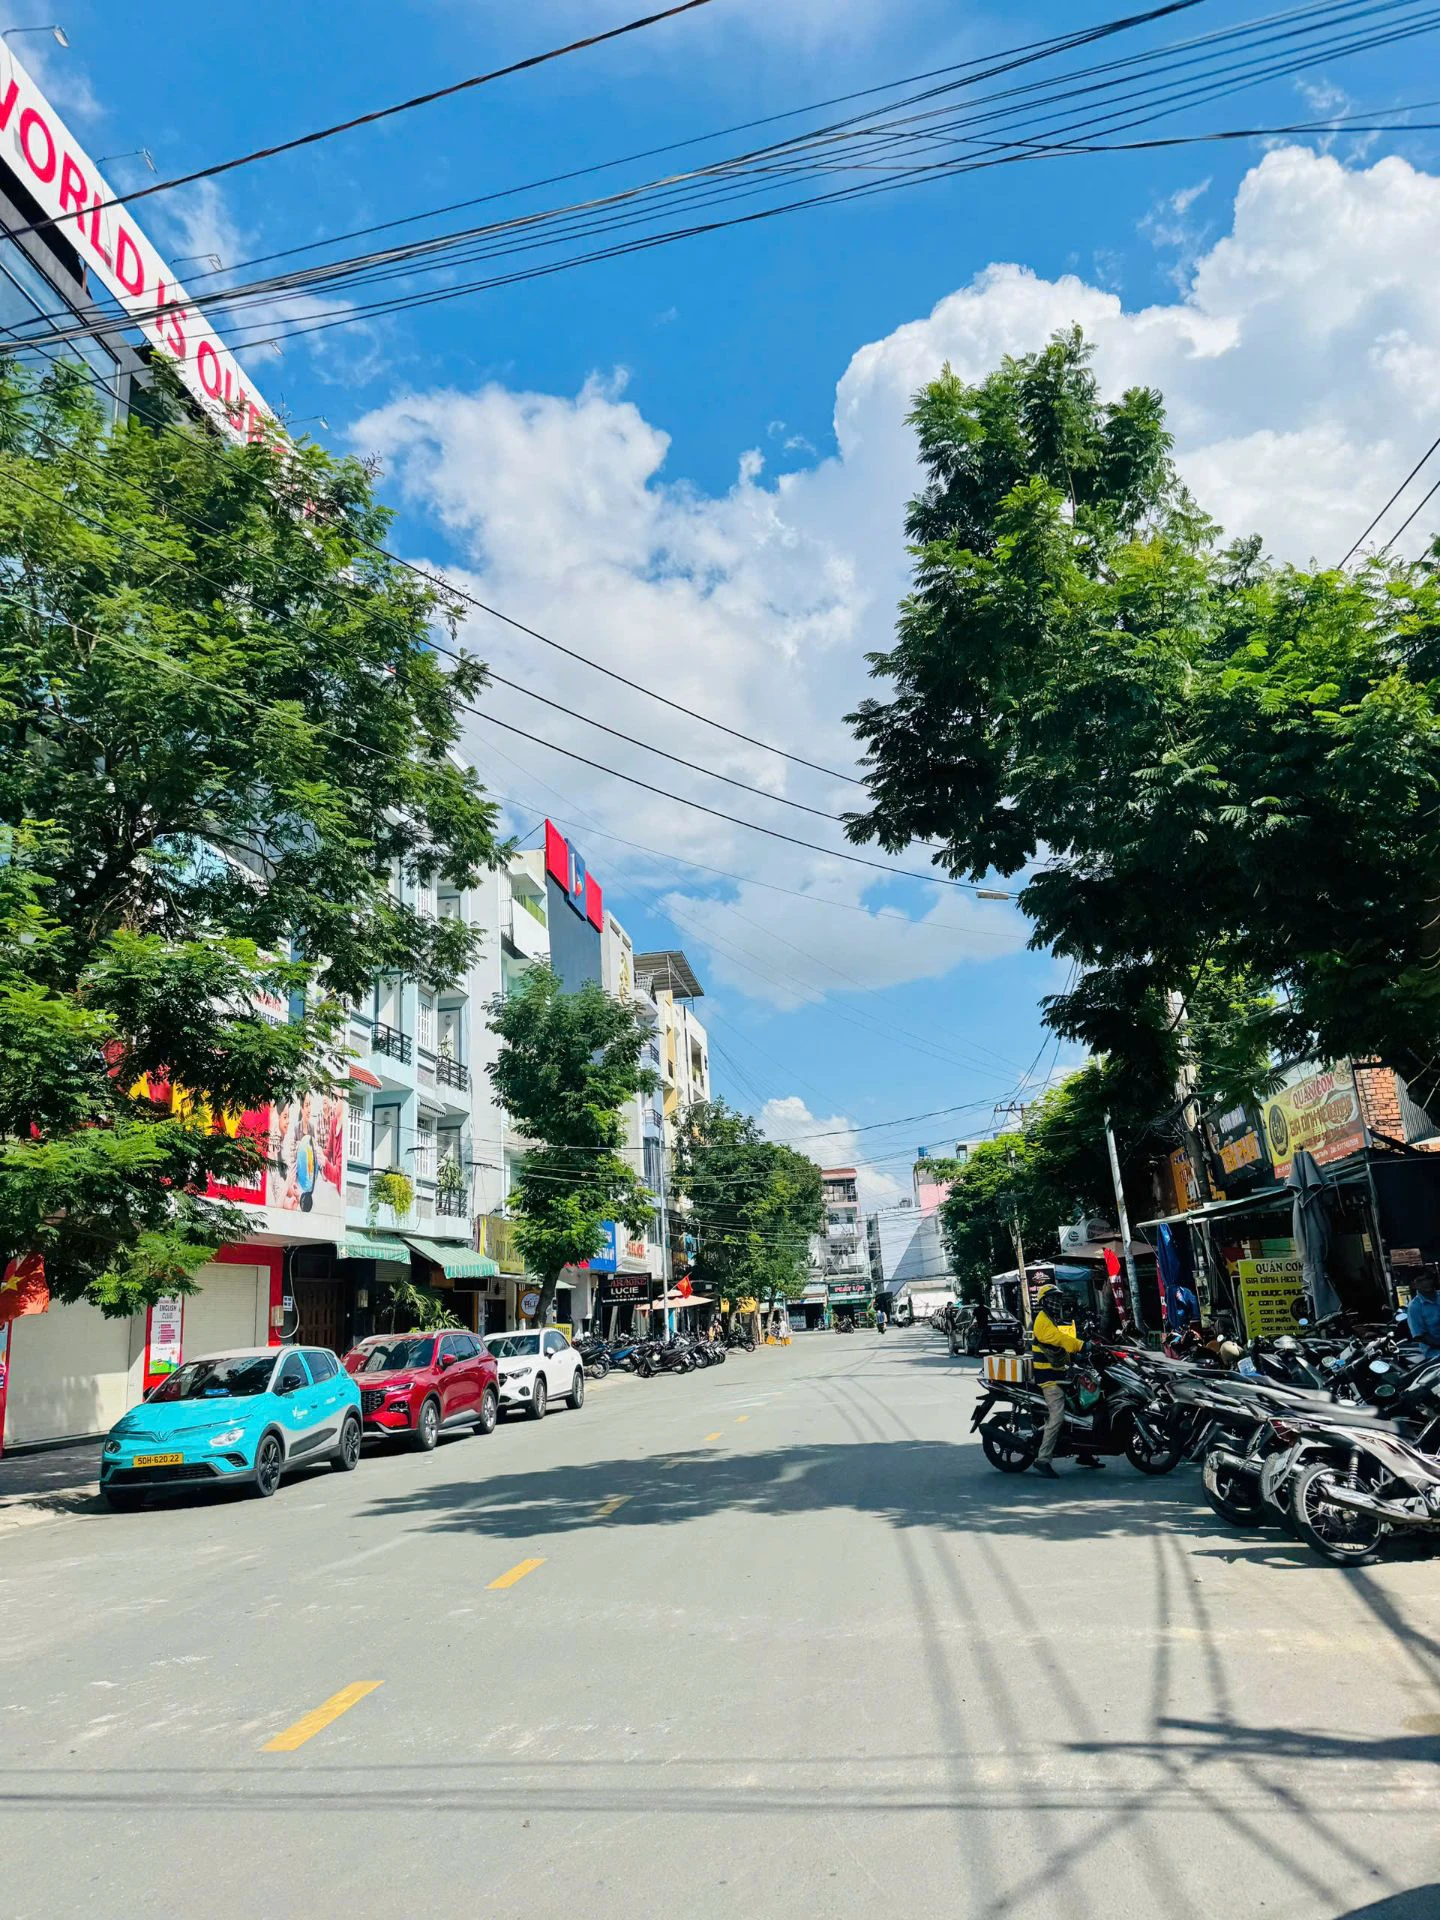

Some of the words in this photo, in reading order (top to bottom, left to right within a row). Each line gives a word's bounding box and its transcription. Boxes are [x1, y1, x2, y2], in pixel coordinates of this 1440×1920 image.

[155, 277, 187, 358] IS
[1256, 1260, 1283, 1274] QUÁN
[610, 1286, 639, 1295] LUCIE
